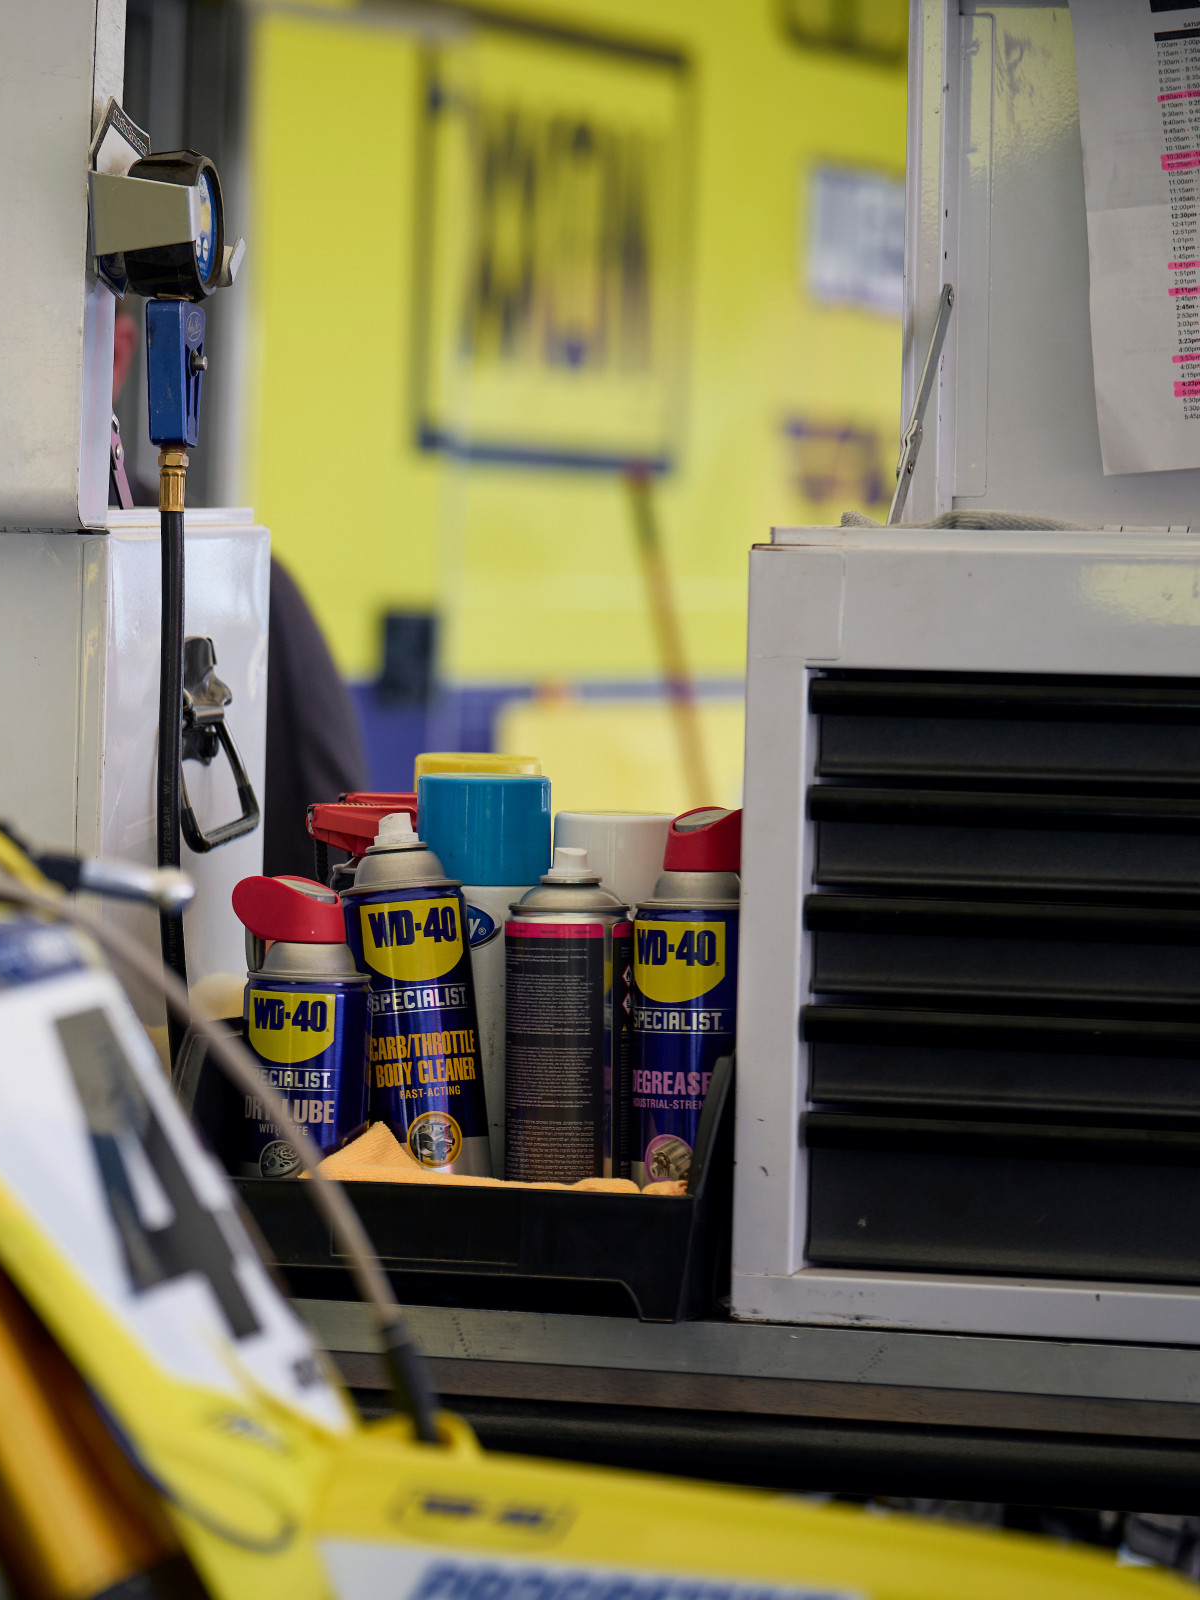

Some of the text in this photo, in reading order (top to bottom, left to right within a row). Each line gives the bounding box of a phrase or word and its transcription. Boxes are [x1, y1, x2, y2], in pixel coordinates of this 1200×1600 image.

[368, 906, 457, 949] WD-40
[636, 928, 717, 967] WD-40
[253, 996, 328, 1033] WD-40
[370, 986, 467, 1013] SPECIALIST
[633, 1011, 721, 1031] SPECIALIST
[370, 1030, 476, 1062] CARB/THROTTLE
[375, 1057, 476, 1088] BODY CLEANER
[632, 1068, 713, 1096] DEGREASE
[399, 1085, 461, 1100] FAST-ACTING
